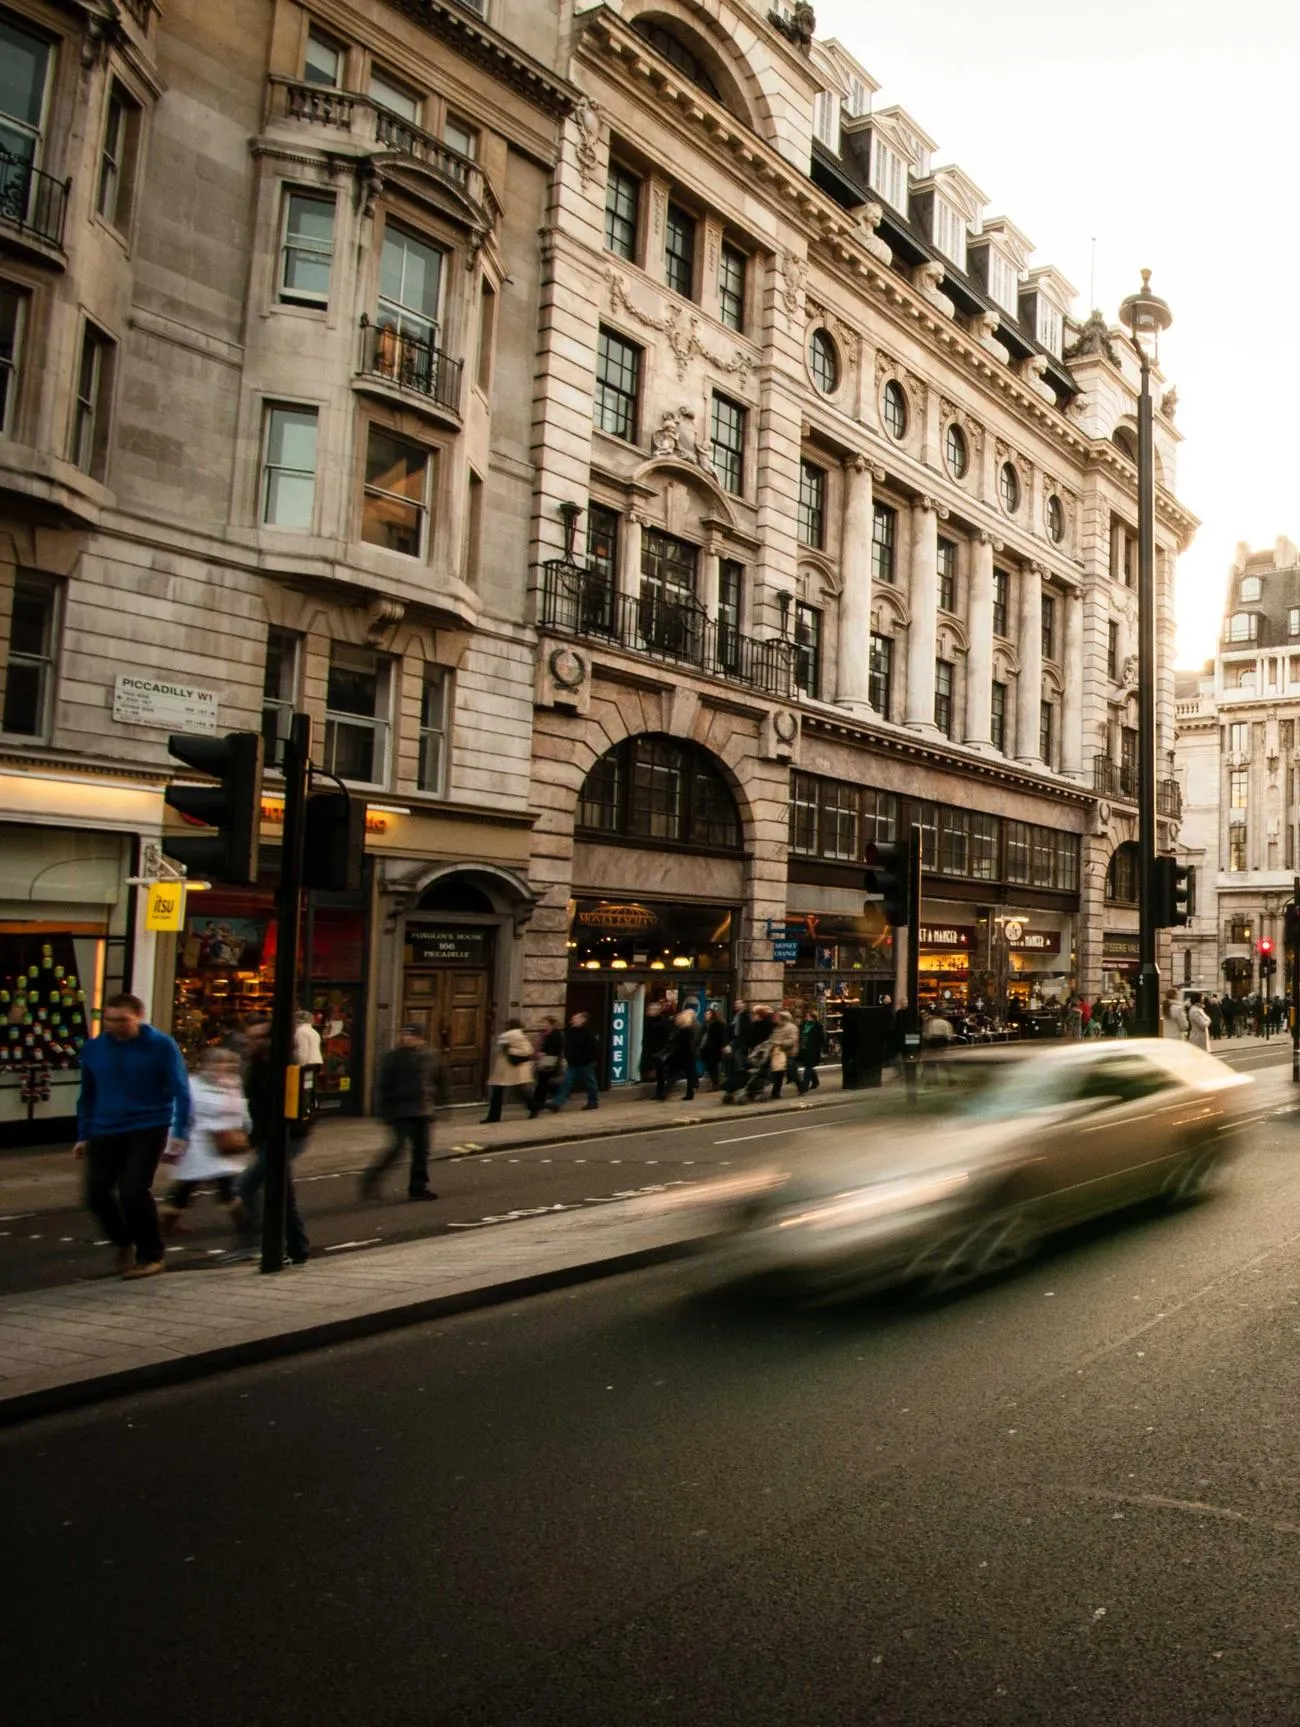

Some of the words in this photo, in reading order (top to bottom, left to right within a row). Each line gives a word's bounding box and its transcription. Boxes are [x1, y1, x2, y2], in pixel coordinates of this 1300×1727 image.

[122, 678, 193, 698] PICCADILLY
[197, 691, 213, 702] W1
[153, 894, 174, 913] itsu
[612, 1002, 625, 1078] MONEY
